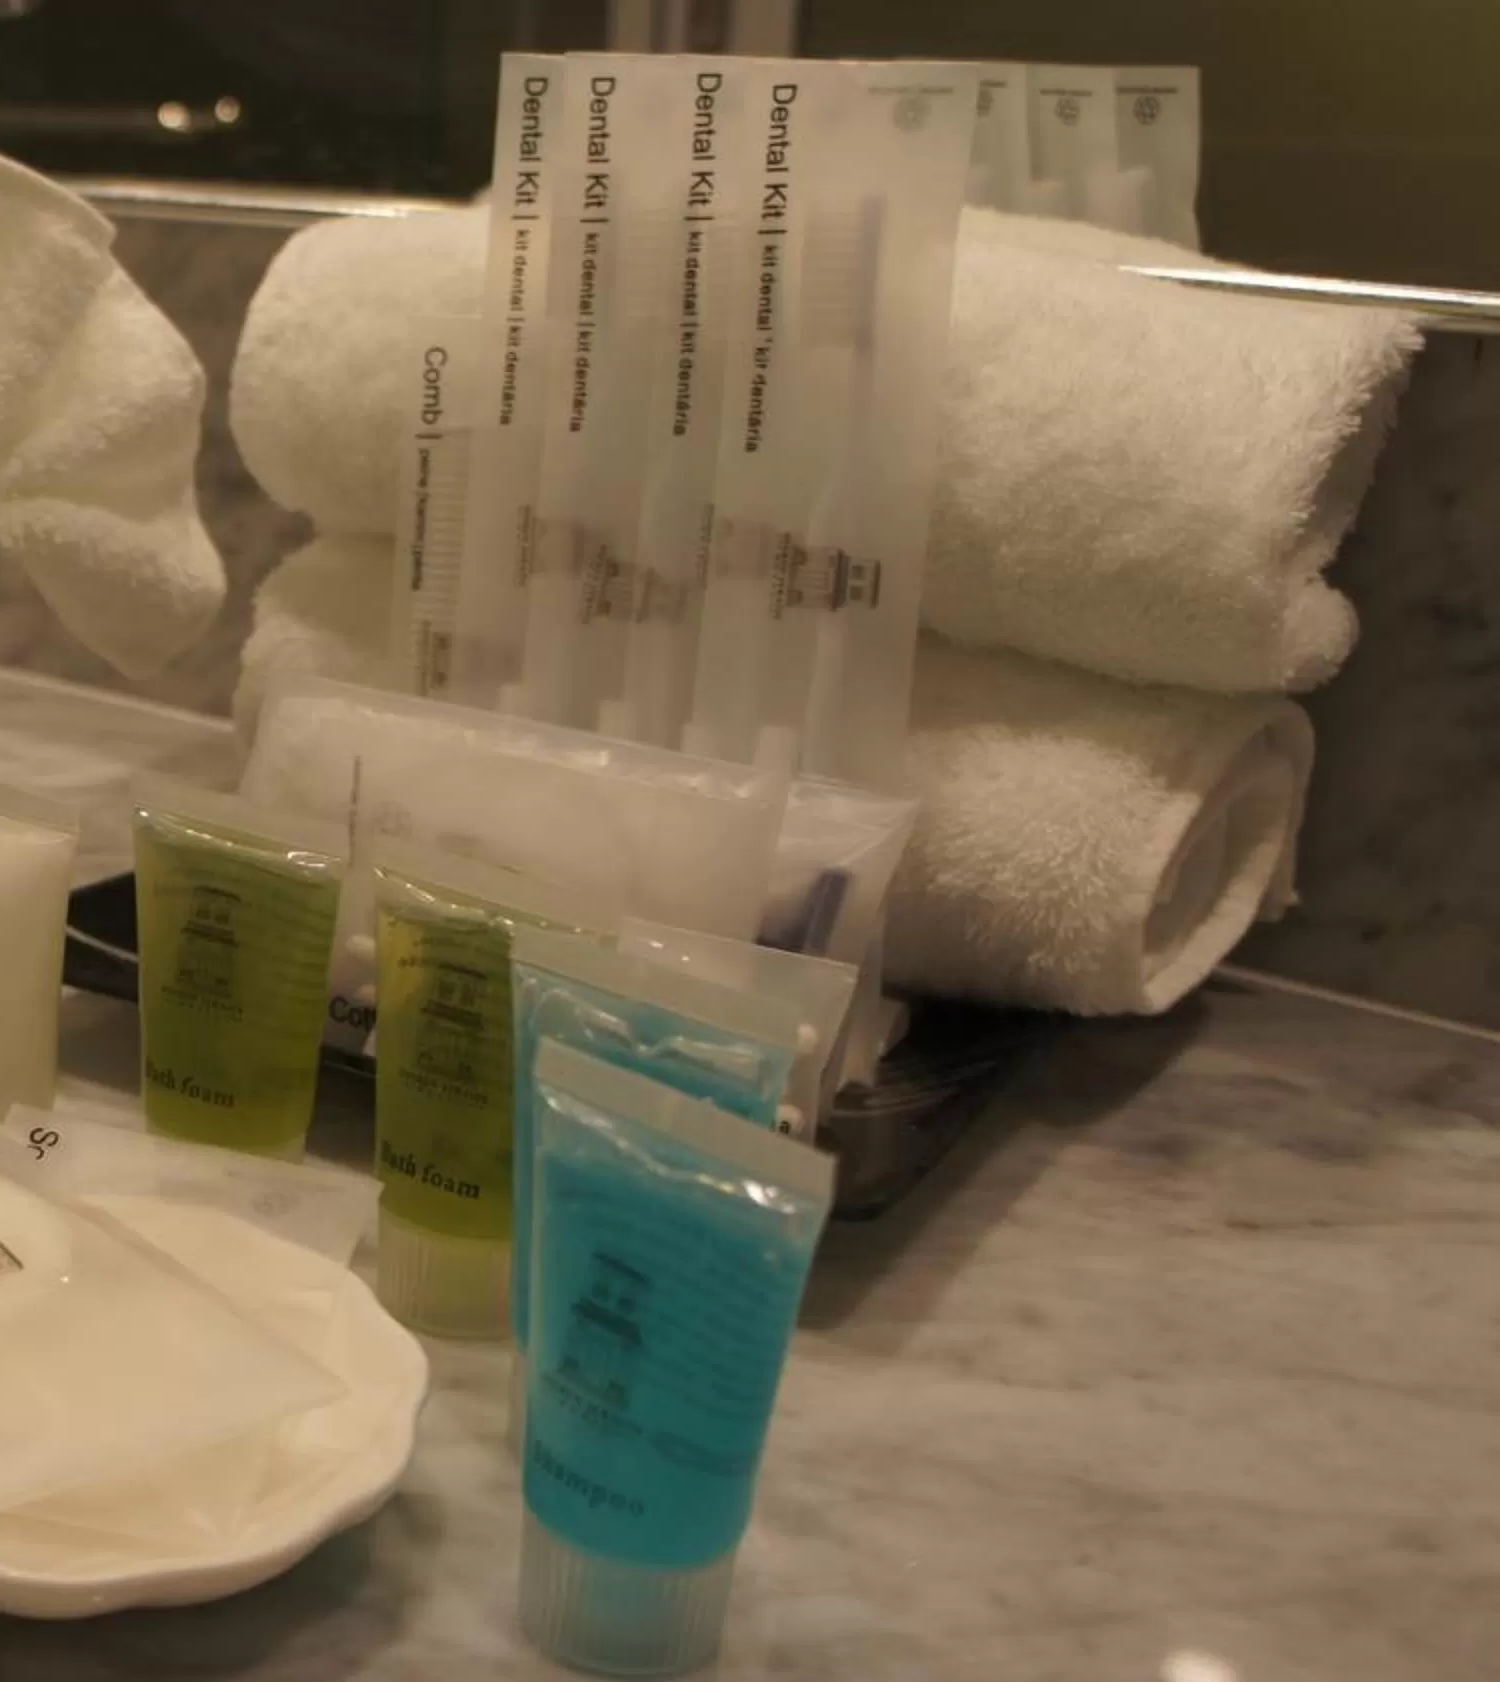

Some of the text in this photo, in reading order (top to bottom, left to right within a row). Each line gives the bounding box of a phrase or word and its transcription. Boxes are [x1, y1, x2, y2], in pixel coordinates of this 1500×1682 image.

[519, 77, 549, 162] Dental
[586, 76, 616, 163] Dental
[692, 73, 724, 161] Dental
[765, 83, 799, 173] Dental
[515, 171, 541, 207] Kit
[583, 173, 610, 209] Kit
[687, 171, 716, 208] Kit
[761, 183, 789, 221] Kit
[515, 228, 531, 251] kit
[583, 231, 600, 255] kit
[686, 231, 704, 254] kit
[761, 244, 779, 267] kit
[509, 255, 527, 312] dental
[579, 258, 597, 316] dental
[682, 257, 700, 317] dental
[756, 272, 775, 331] dental
[420, 345, 448, 425] Comb
[180, 1076, 235, 1107] foam
[421, 1162, 481, 1200] foam
